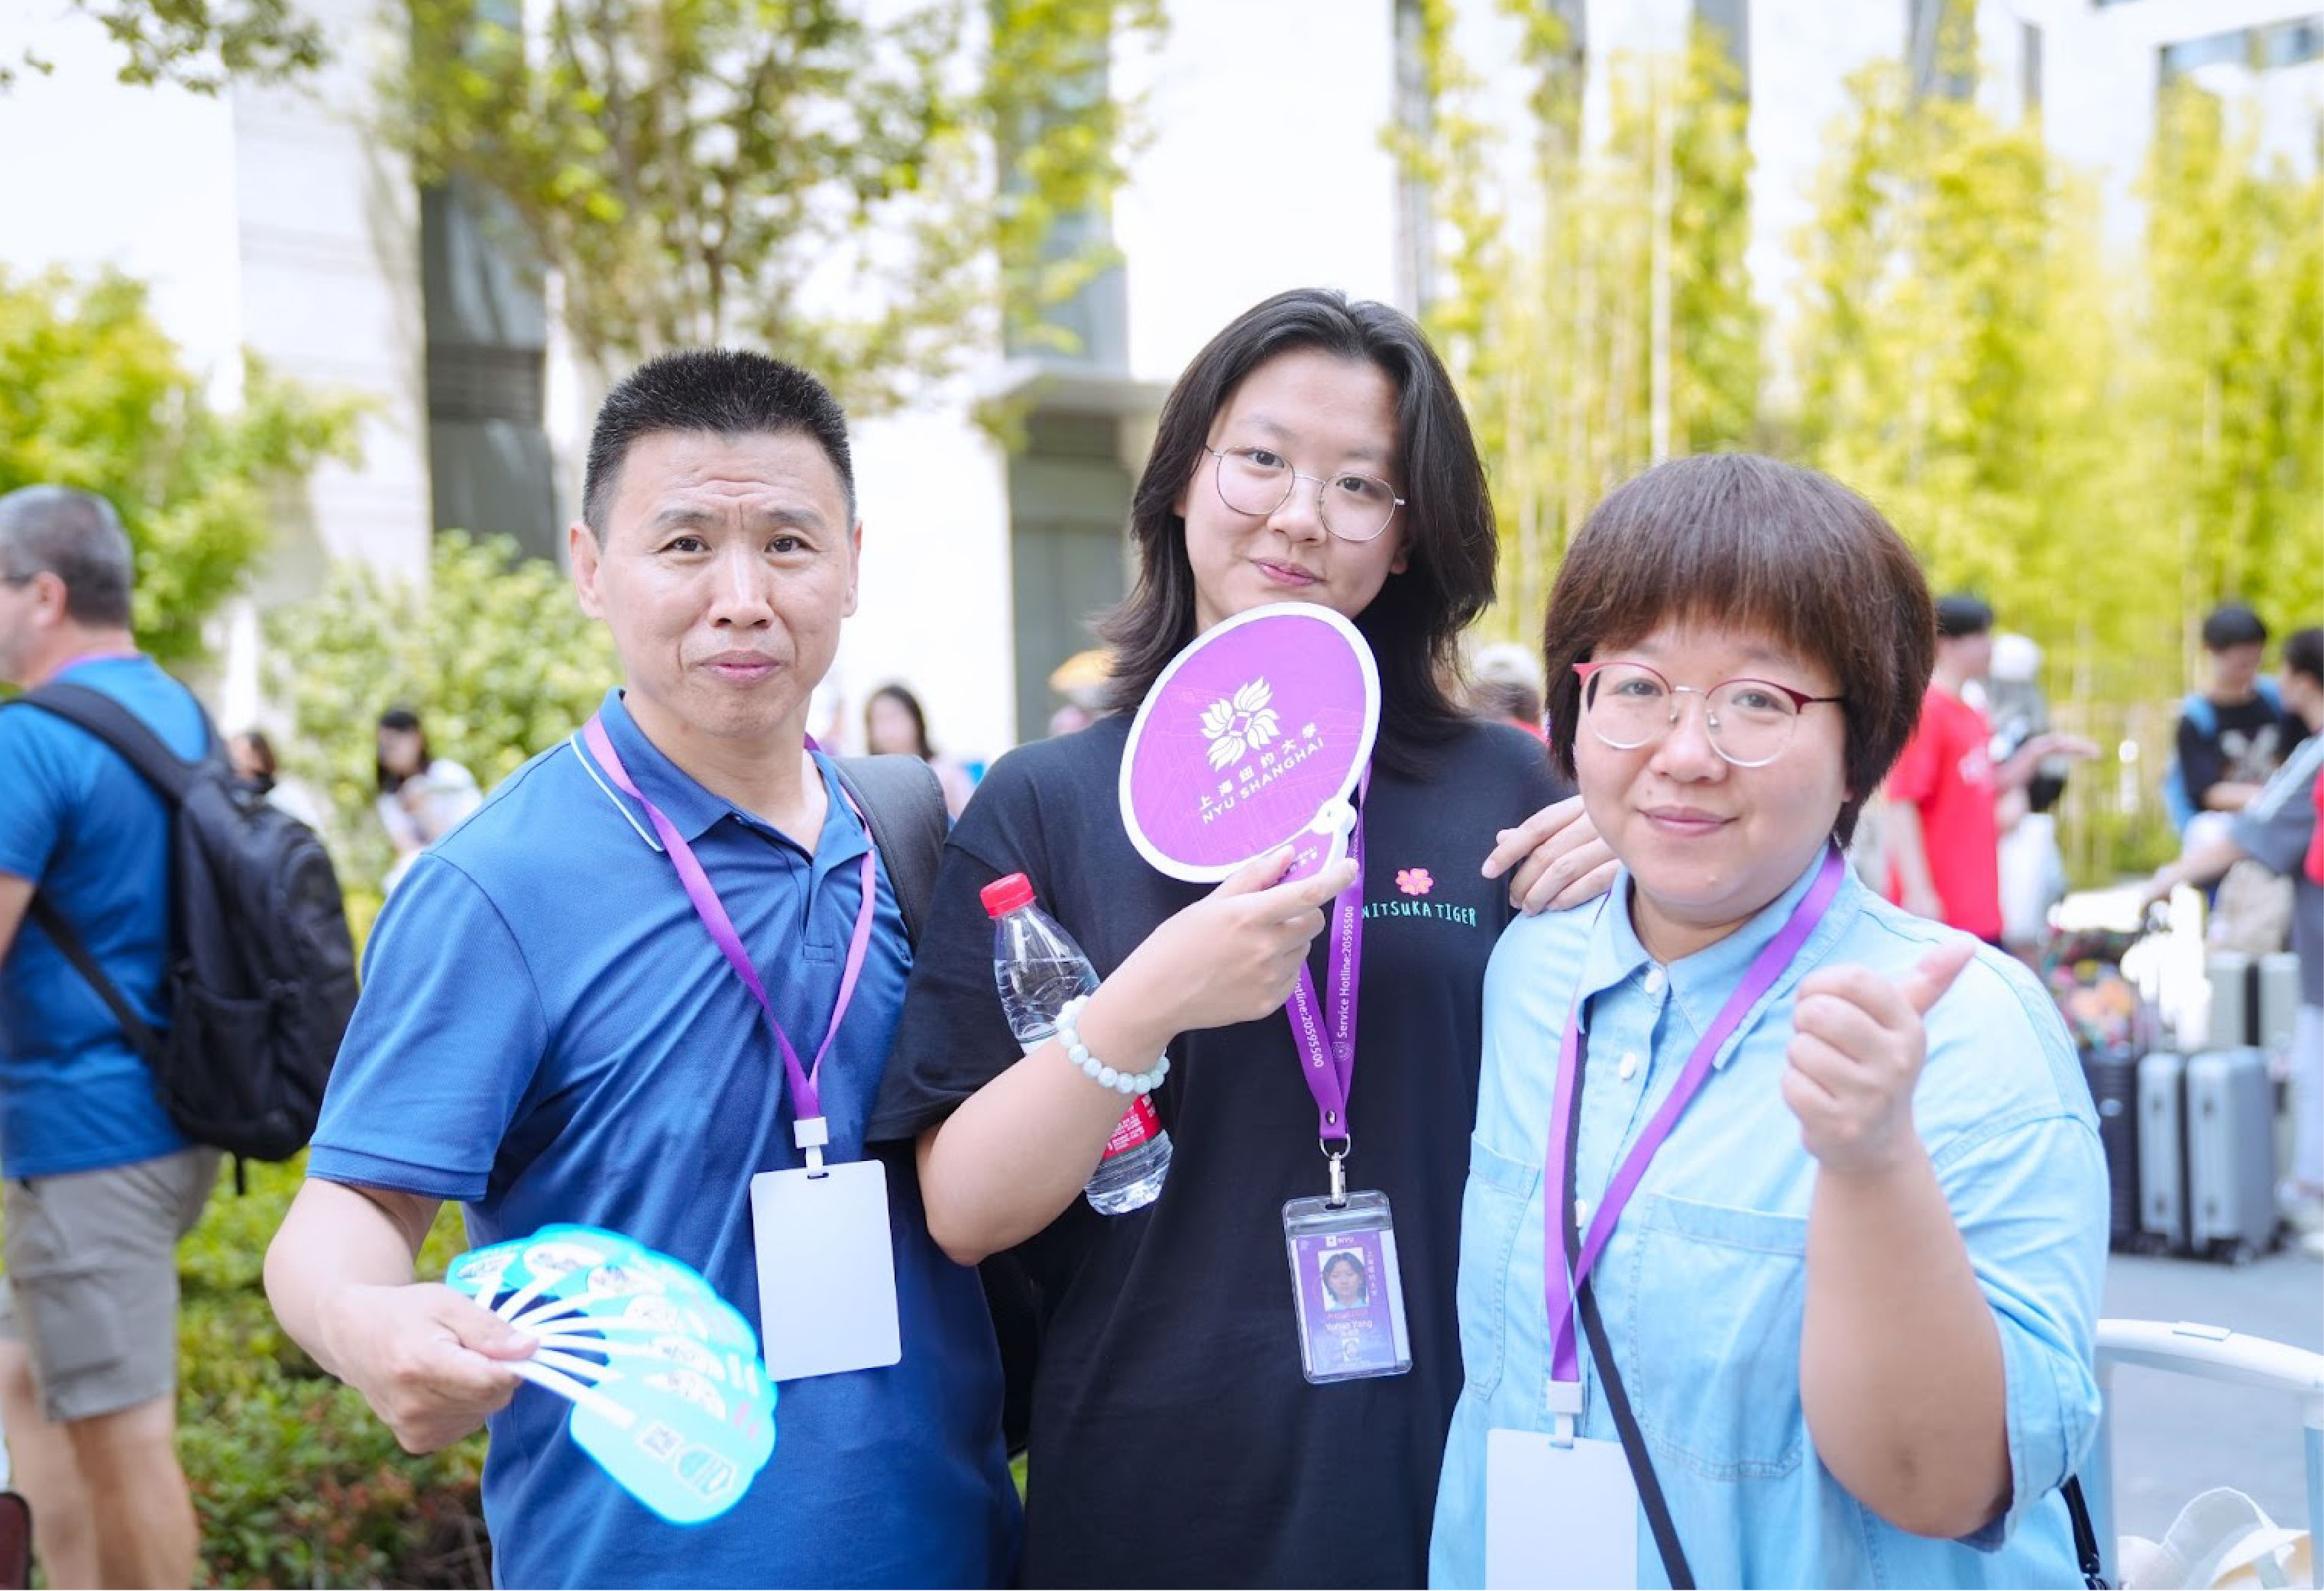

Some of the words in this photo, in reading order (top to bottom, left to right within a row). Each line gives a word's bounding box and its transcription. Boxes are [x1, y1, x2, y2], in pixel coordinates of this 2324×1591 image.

[1202, 798, 1235, 824] NYU
[1240, 737, 1325, 799] SHANGHAI
[1361, 901, 1432, 918] NITSUKA
[1435, 903, 1477, 927] TIGER
[1295, 977, 1324, 1068] otline:20595500
[1337, 998, 1349, 1039] Service
